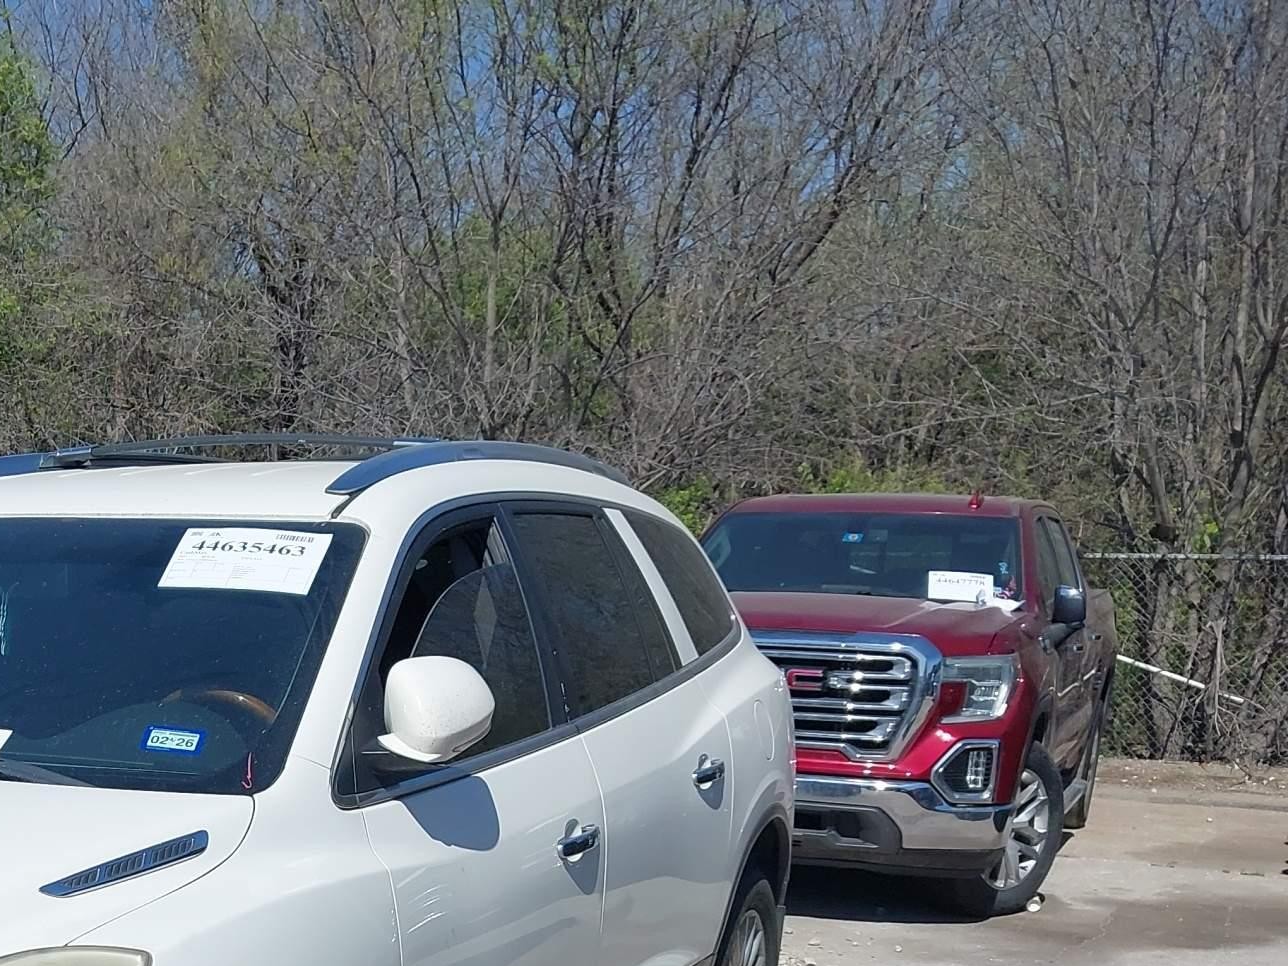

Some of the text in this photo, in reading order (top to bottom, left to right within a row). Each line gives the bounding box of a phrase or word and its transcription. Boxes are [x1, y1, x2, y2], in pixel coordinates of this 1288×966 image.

[192, 540, 306, 557] 44635463
[150, 735, 195, 748] 02 26
